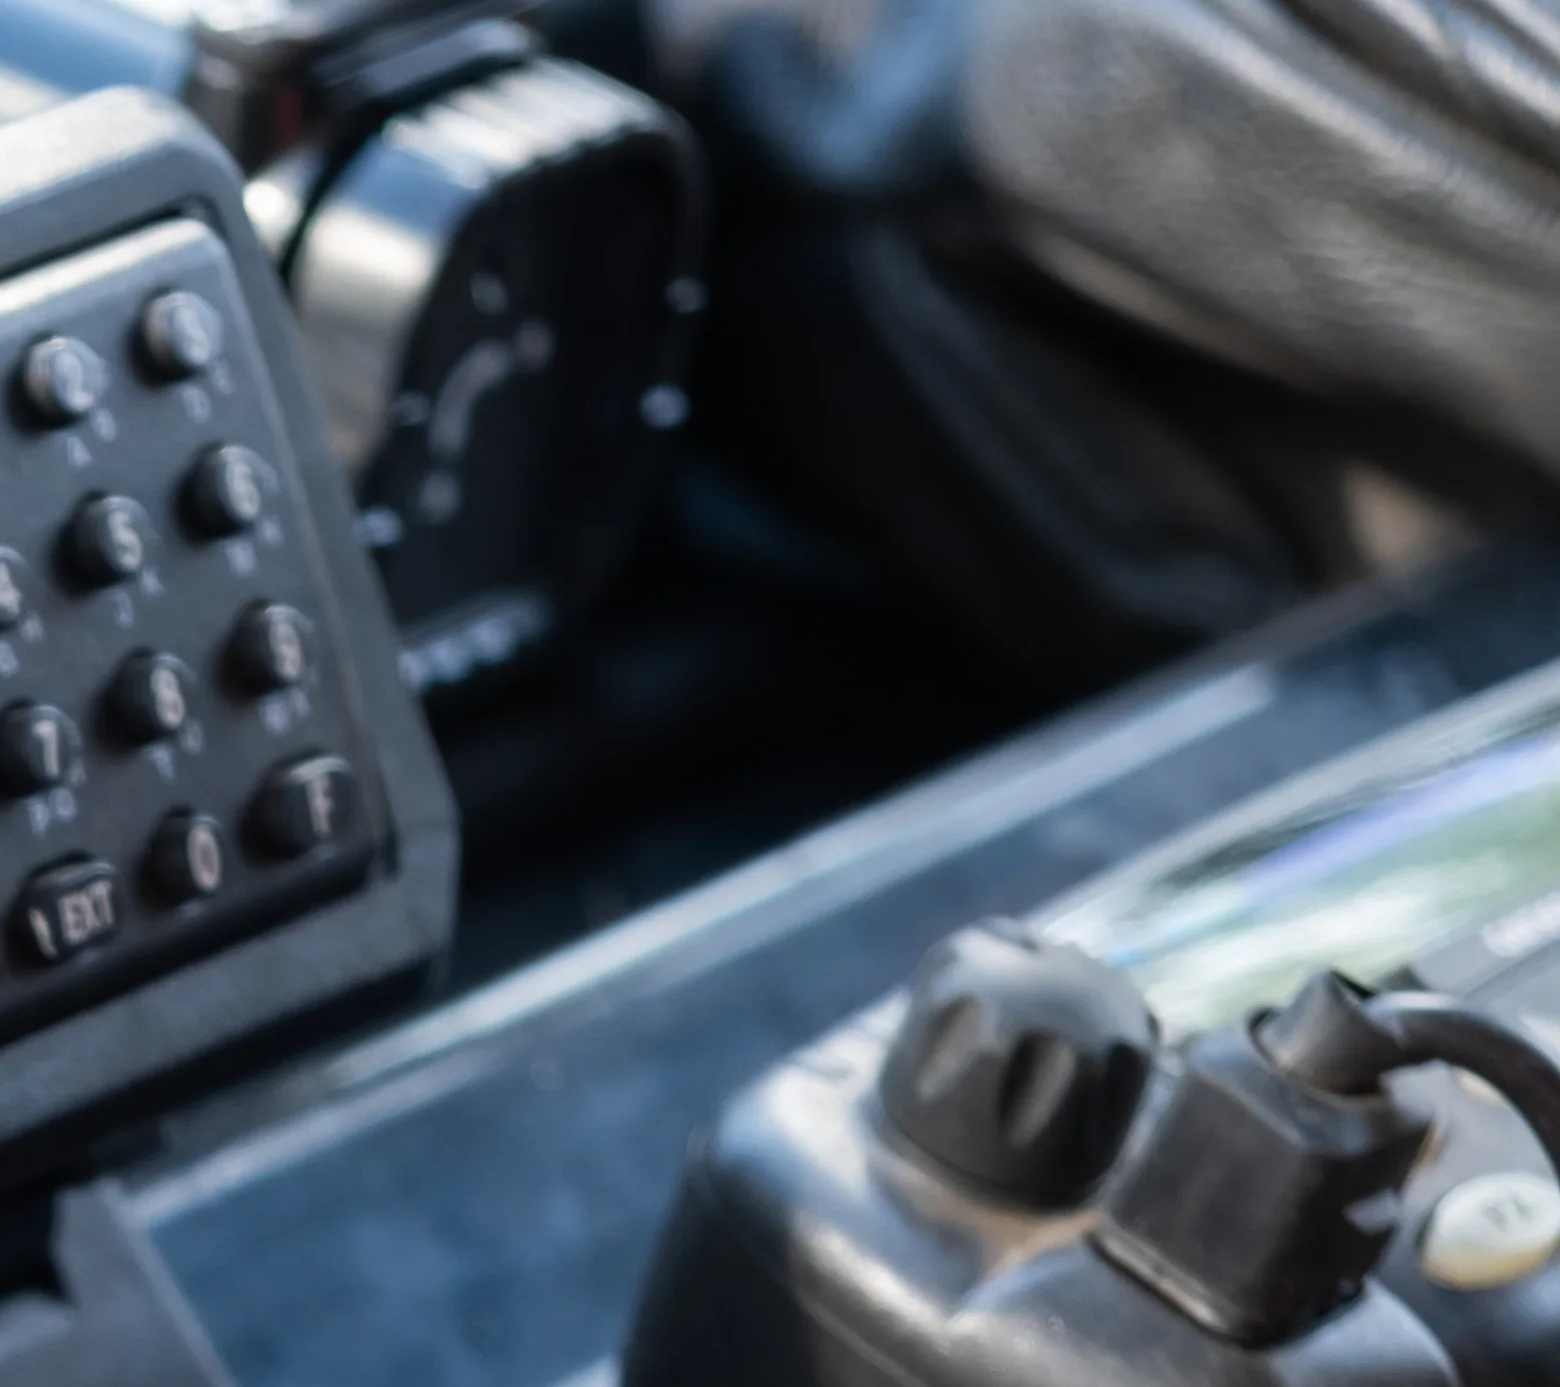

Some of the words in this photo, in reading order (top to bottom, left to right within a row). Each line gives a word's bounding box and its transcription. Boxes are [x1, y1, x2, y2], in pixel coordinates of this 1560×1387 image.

[52, 351, 96, 413] 2
[106, 510, 143, 573] 5
[225, 461, 261, 521] 6
[149, 665, 186, 731] 8
